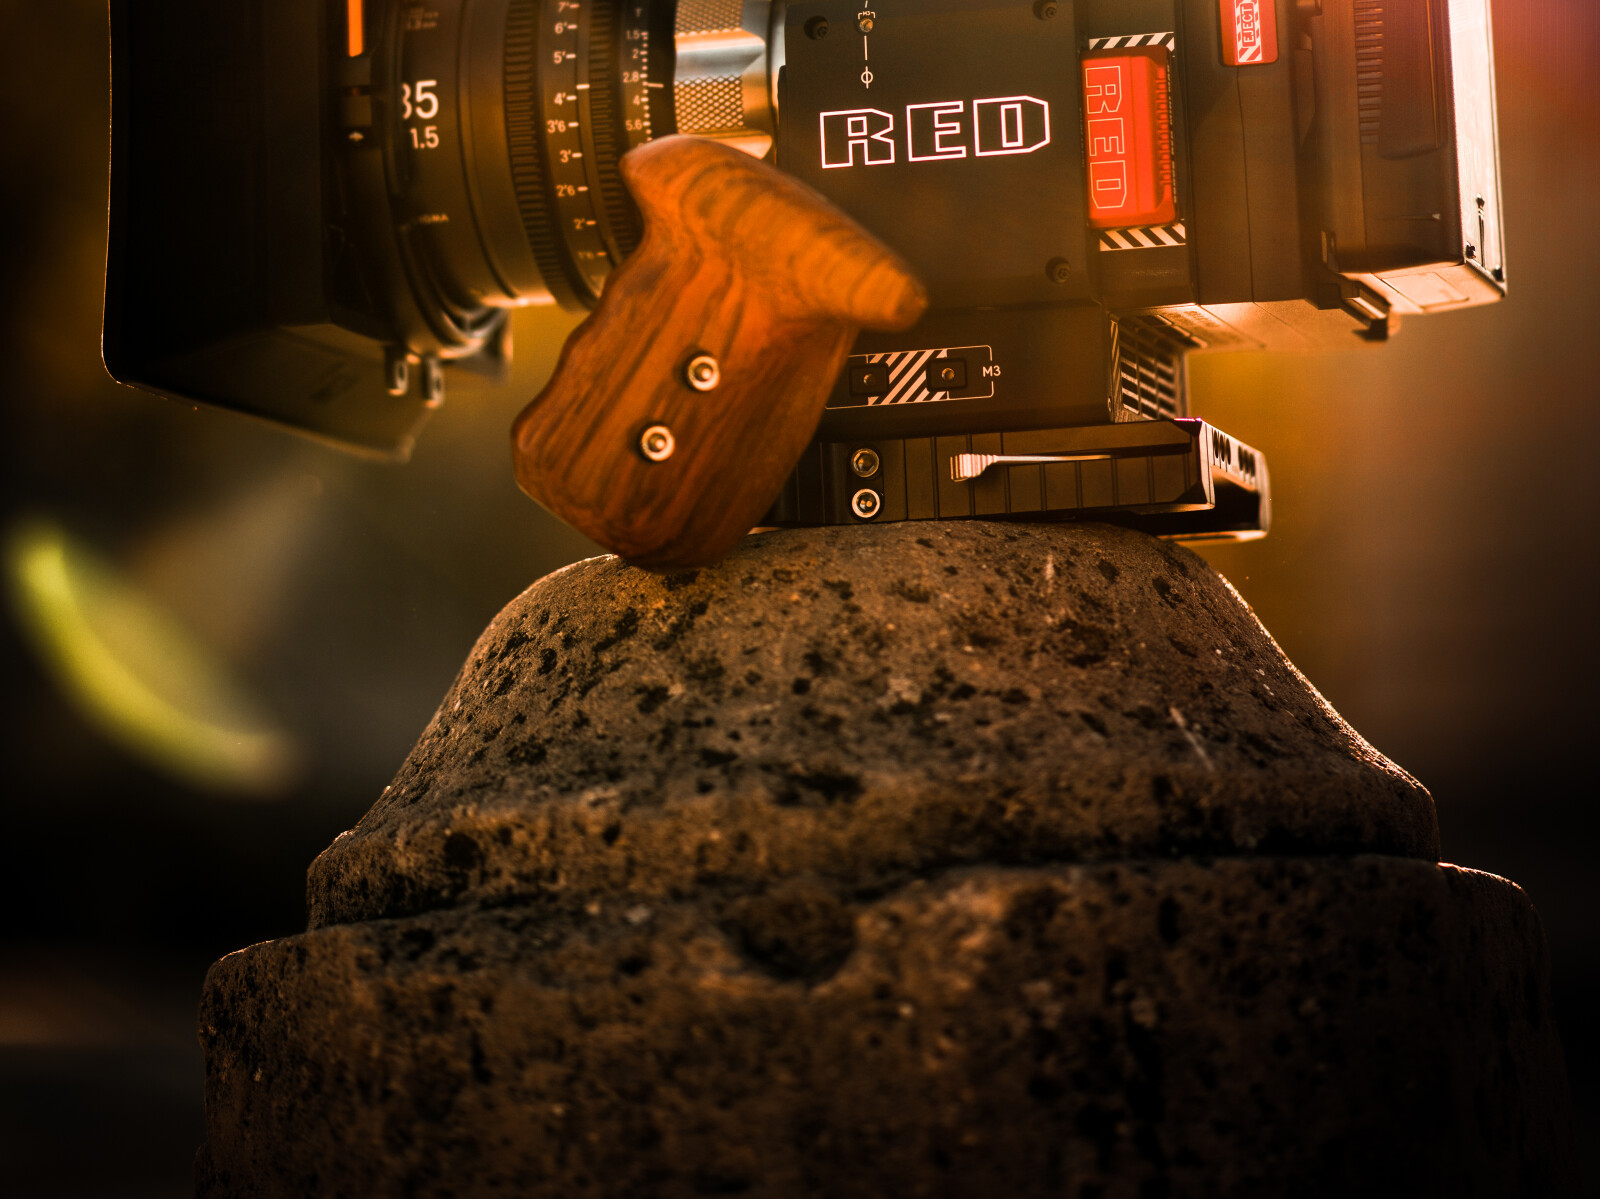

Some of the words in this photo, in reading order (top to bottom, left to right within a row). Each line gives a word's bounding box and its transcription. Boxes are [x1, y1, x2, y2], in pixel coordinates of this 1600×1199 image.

[555, 21, 567, 34] 6'
[1241, 6, 1255, 43] EJECT
[626, 30, 640, 40] 1.5
[553, 50, 566, 64] 5'
[632, 48, 640, 60] 2
[623, 71, 639, 84] 2.8
[554, 92, 566, 105] 4'
[632, 95, 641, 106] 4
[626, 119, 642, 131] 5.6
[410, 125, 440, 149] 1.5
[819, 95, 1051, 169] RED
[1085, 65, 1127, 210] RED
[560, 149, 571, 163] 3'
[982, 364, 1002, 378] M3
